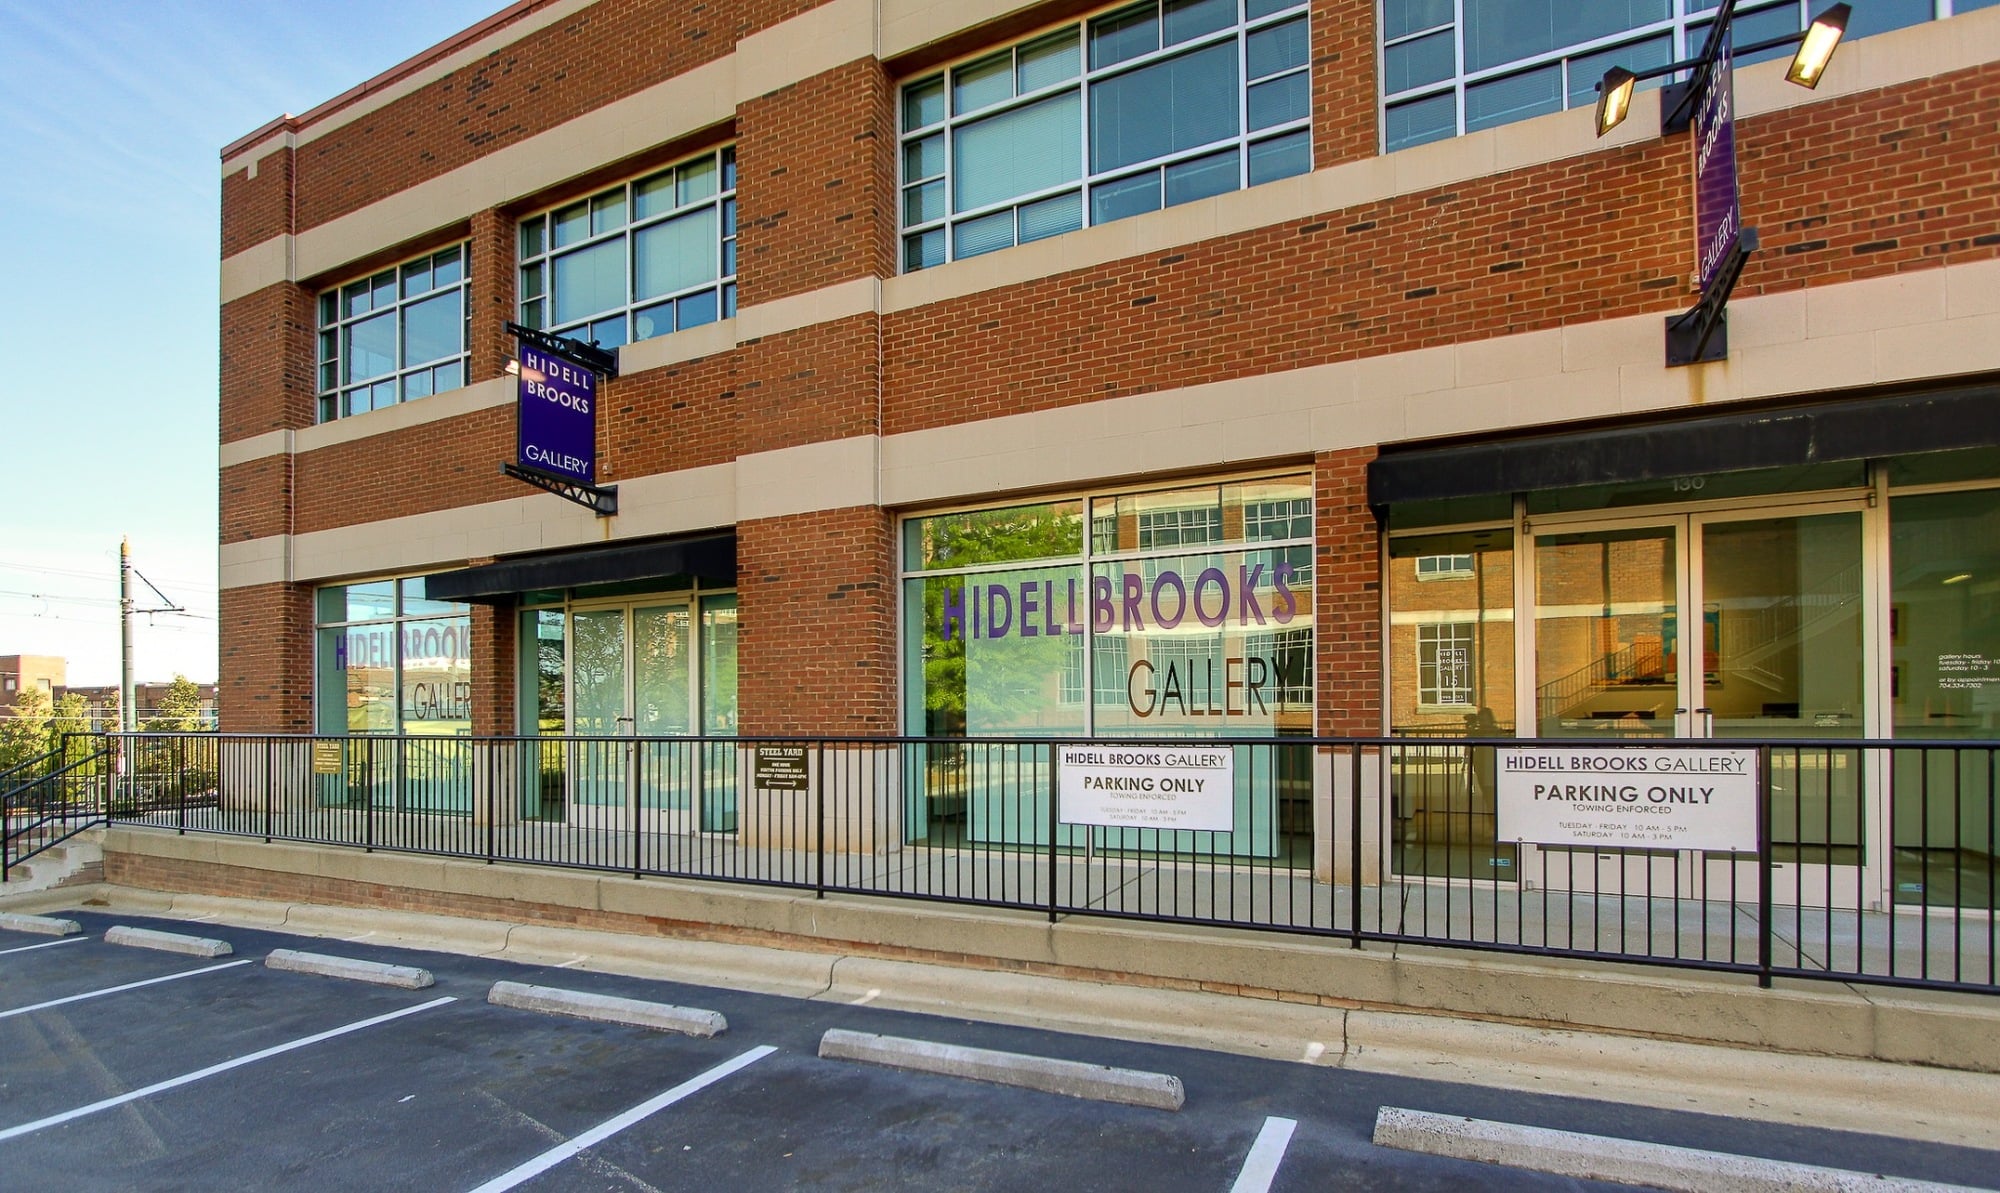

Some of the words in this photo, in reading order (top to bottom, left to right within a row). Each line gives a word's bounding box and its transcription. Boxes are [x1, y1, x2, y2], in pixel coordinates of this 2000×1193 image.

[1696, 45, 1728, 136] HIDELL
[1698, 90, 1728, 178] BROOKS
[1701, 206, 1734, 282] GALLERY
[527, 352, 589, 390] HIDELL
[527, 379, 589, 414] BROOKS
[526, 444, 588, 474] GALLERY
[1674, 476, 1706, 492] 130
[1128, 656, 1294, 718] GALLERY
[760, 748, 782, 756] STEEL
[783, 748, 803, 756] YARD
[1065, 752, 1104, 764] HIDELL
[1108, 753, 1161, 766] BROOKS
[1164, 754, 1226, 767] GALLERY
[1506, 756, 1565, 770] HIDELL
[1571, 757, 1647, 771] BROOKS
[1654, 757, 1746, 772] GALLERY
[1084, 776, 1154, 791] PARKING
[1160, 778, 1205, 793] ONLY
[1534, 784, 1639, 803] PARKING
[1647, 786, 1715, 804] ONLY
[1572, 804, 1614, 812] TOWING
[1616, 805, 1672, 814] ENFORCED
